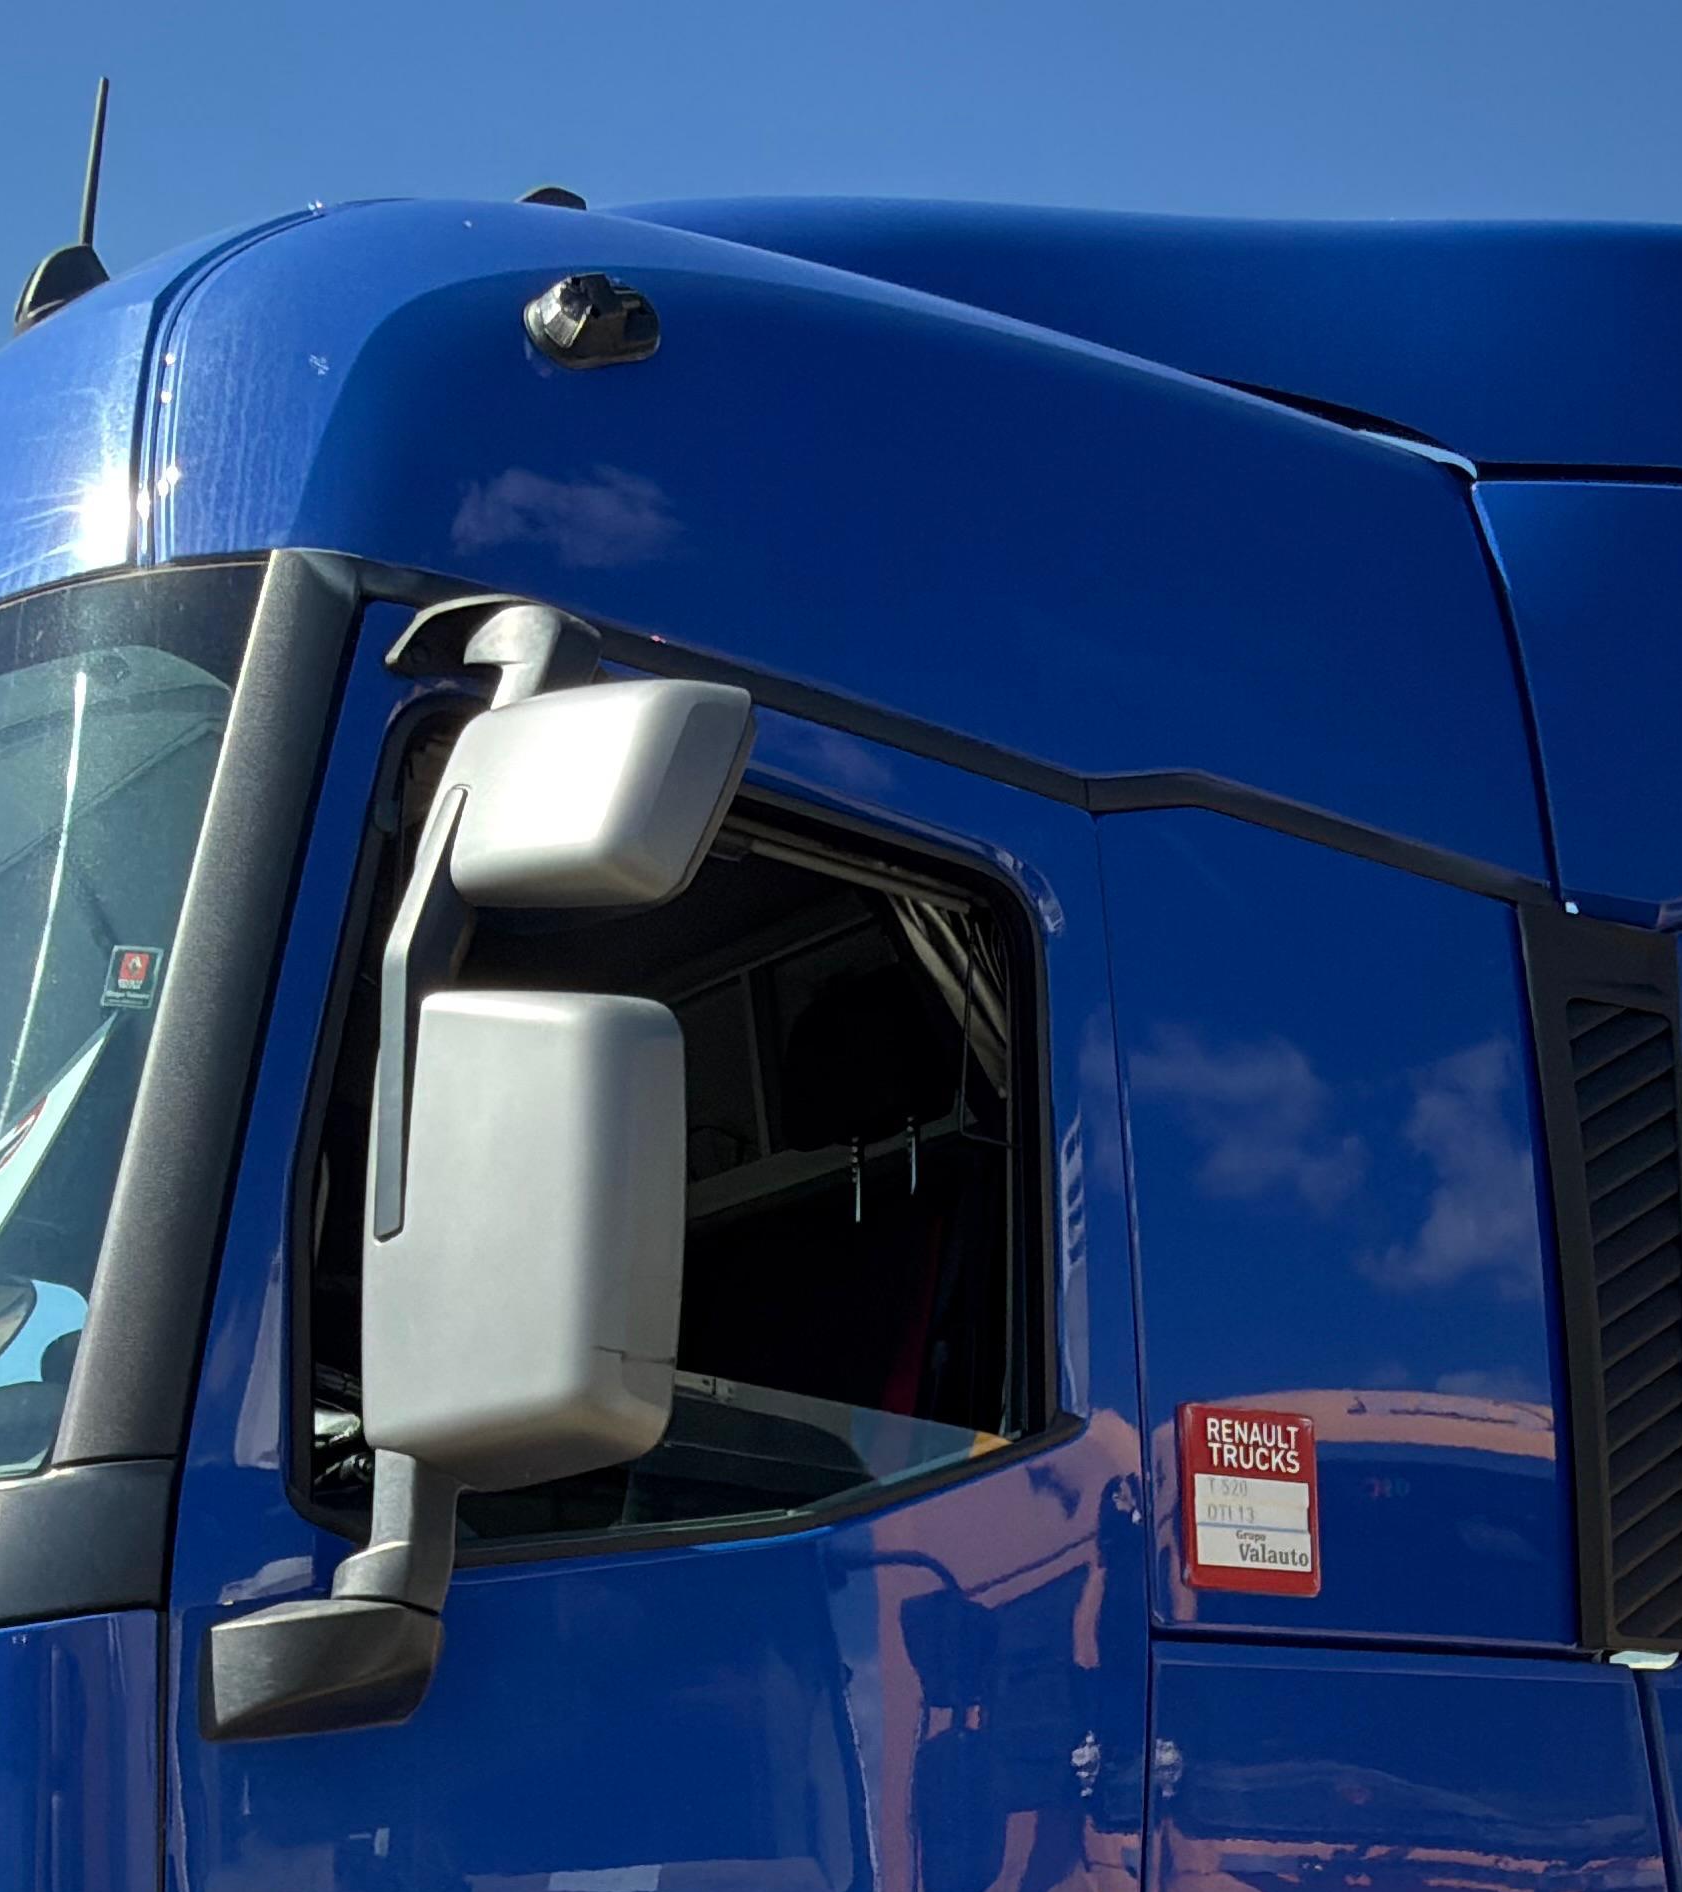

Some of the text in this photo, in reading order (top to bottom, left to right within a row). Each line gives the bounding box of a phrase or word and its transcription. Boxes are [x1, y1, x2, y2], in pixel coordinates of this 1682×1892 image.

[1206, 1417, 1299, 1449] RENAULT
[1208, 1442, 1300, 1473] TRUCKS
[1236, 1530, 1267, 1543] Grupo
[1239, 1543, 1309, 1567] Valauto
